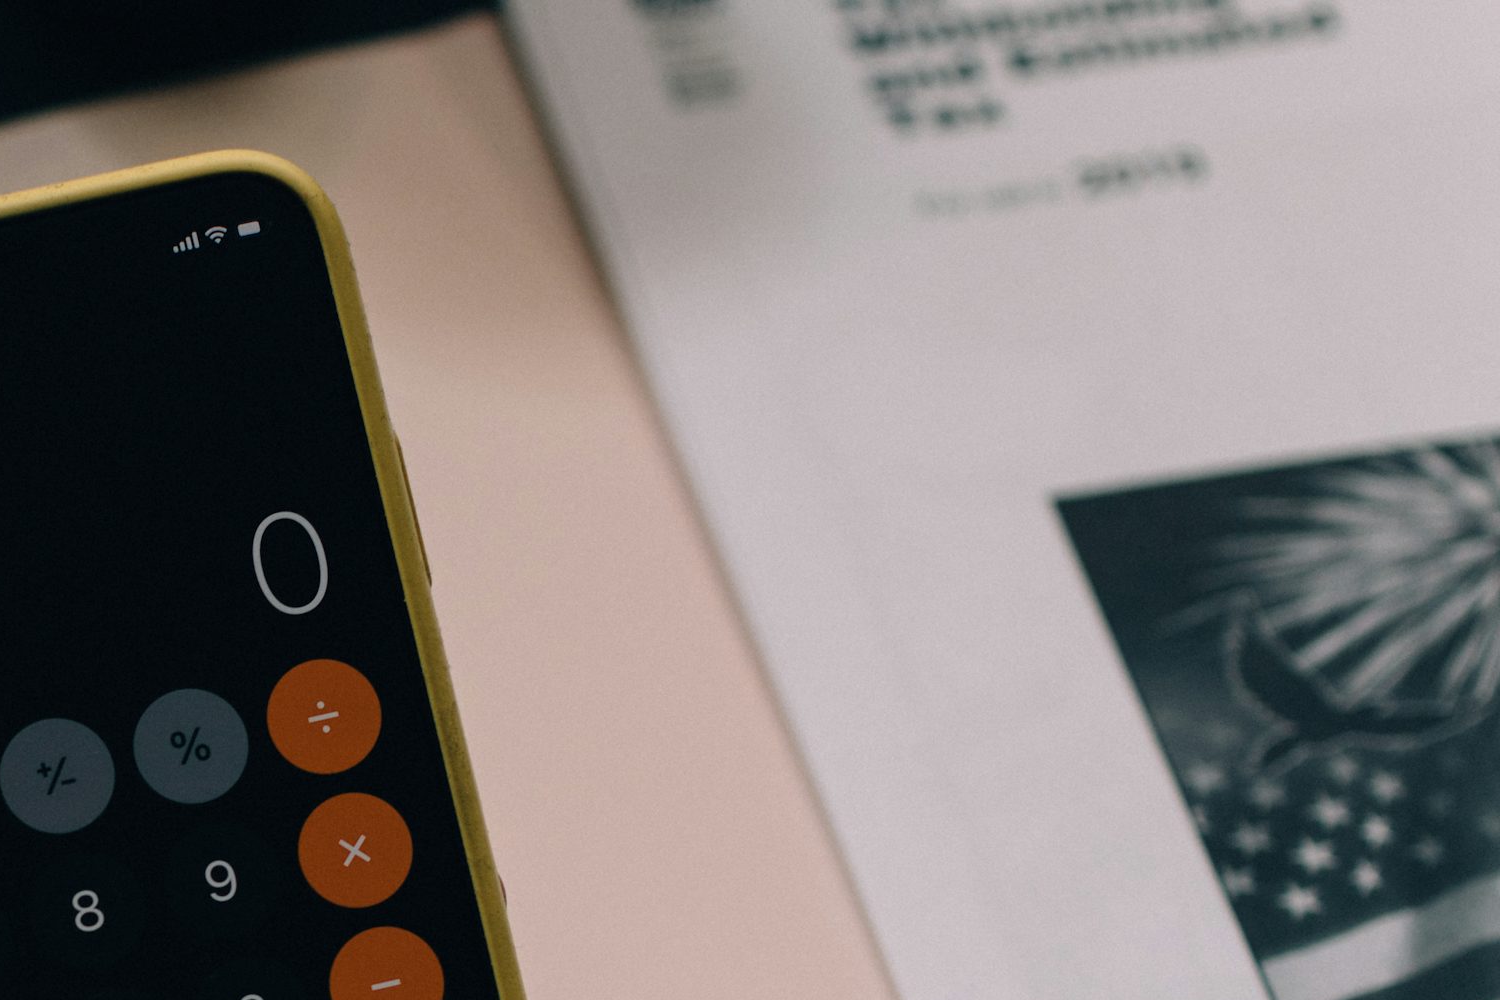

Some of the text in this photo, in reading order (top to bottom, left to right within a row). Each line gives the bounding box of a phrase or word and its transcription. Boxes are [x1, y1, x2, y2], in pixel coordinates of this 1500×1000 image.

[252, 510, 329, 615] 0
[169, 726, 212, 766] %
[71, 888, 106, 933] 8
[203, 859, 238, 903] 9
